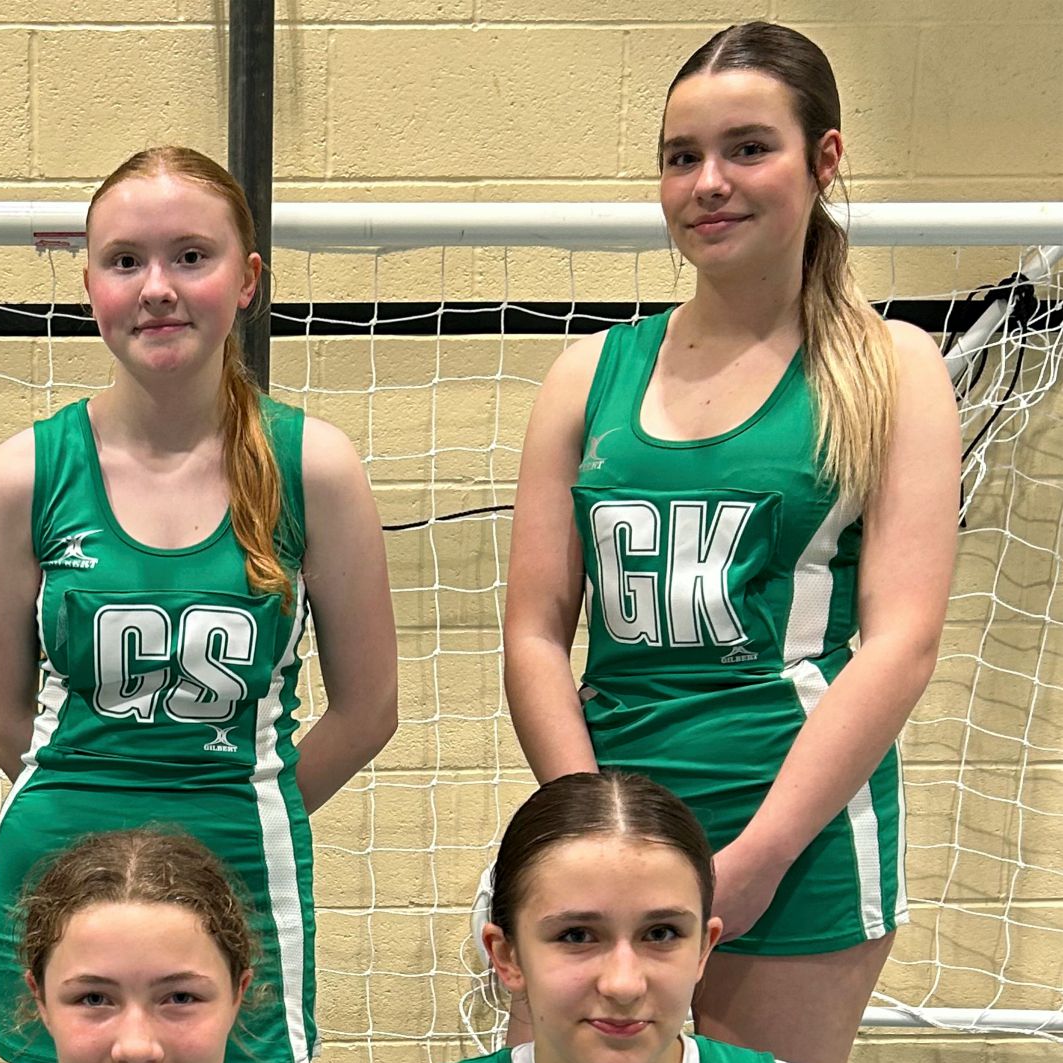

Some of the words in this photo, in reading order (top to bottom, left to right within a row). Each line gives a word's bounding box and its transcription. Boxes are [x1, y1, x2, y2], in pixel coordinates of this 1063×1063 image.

[589, 499, 758, 648] GK
[92, 604, 258, 723] GS
[203, 744, 238, 753] GILBERT
